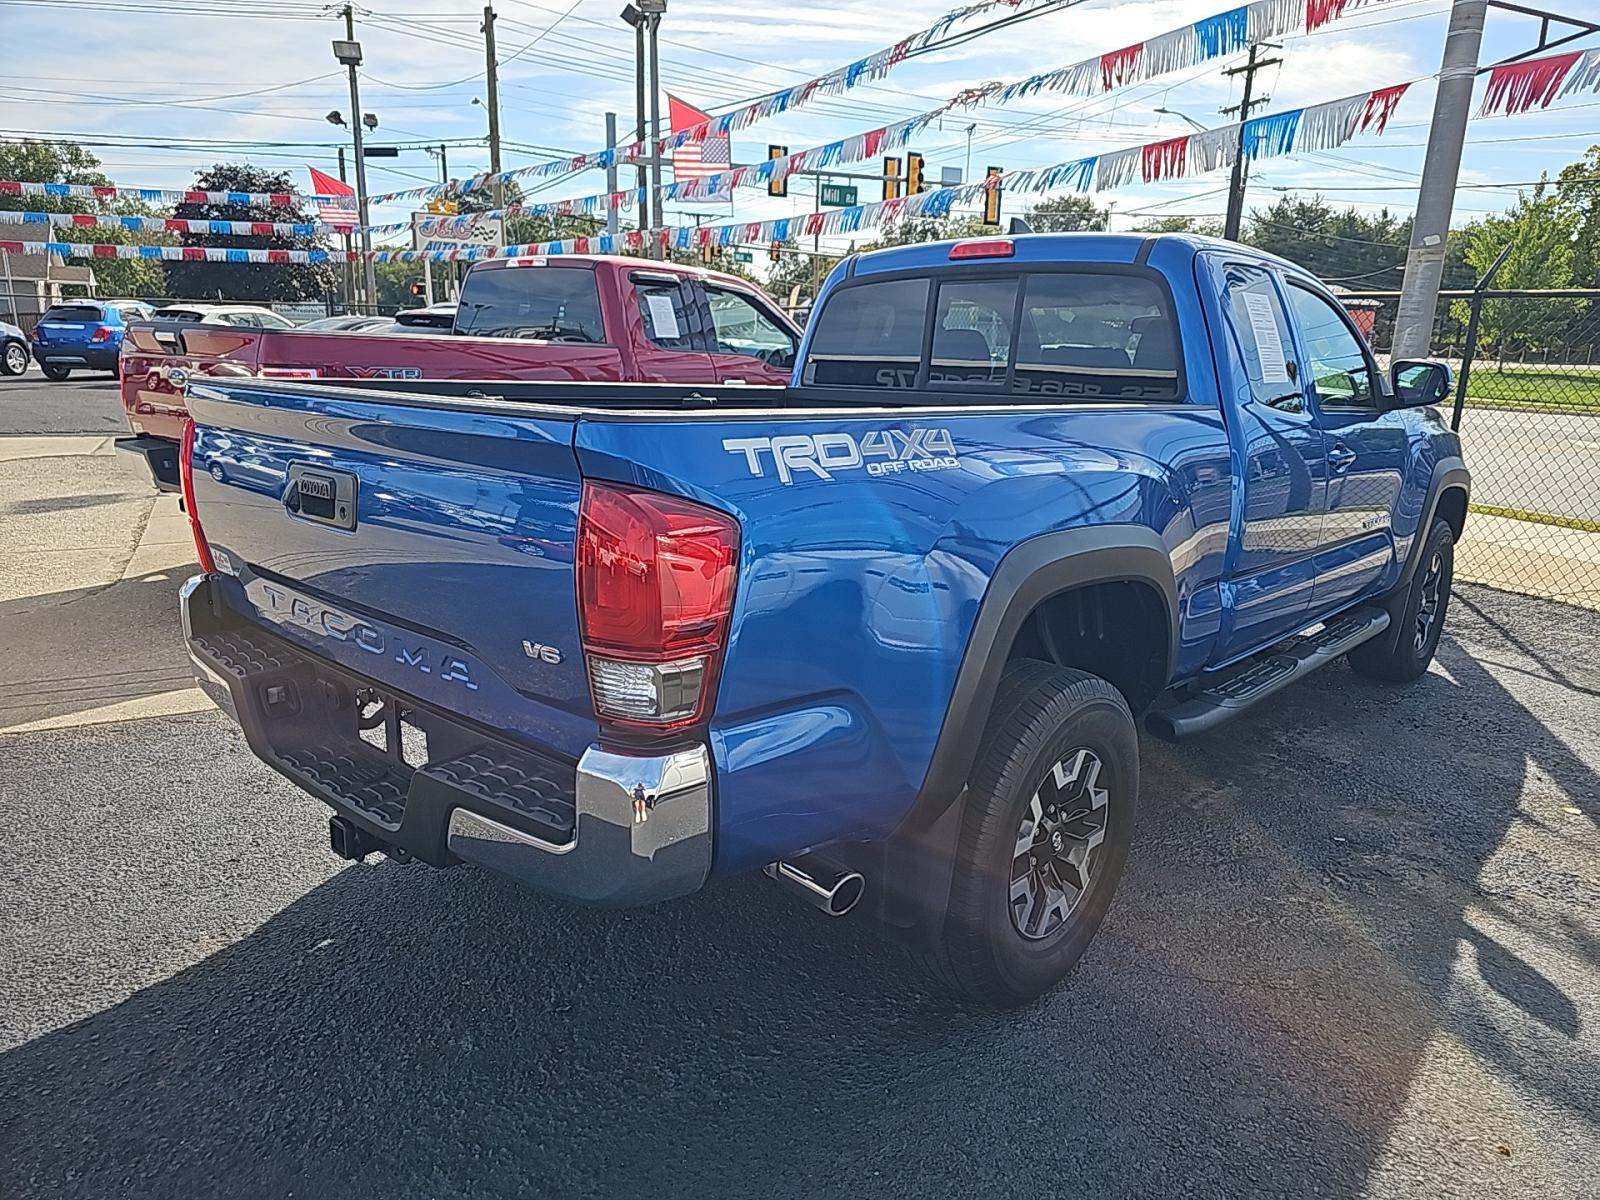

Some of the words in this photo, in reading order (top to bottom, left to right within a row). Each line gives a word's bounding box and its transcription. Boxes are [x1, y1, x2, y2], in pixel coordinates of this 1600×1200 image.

[823, 188, 840, 202] Mill
[722, 432, 863, 486] TRD
[860, 428, 957, 460] 4X4
[866, 459, 905, 477] OFF
[908, 455, 962, 473] ROAD
[299, 478, 330, 498] TOYOTA
[262, 585, 479, 690] TACOMA
[521, 638, 562, 665] V6
